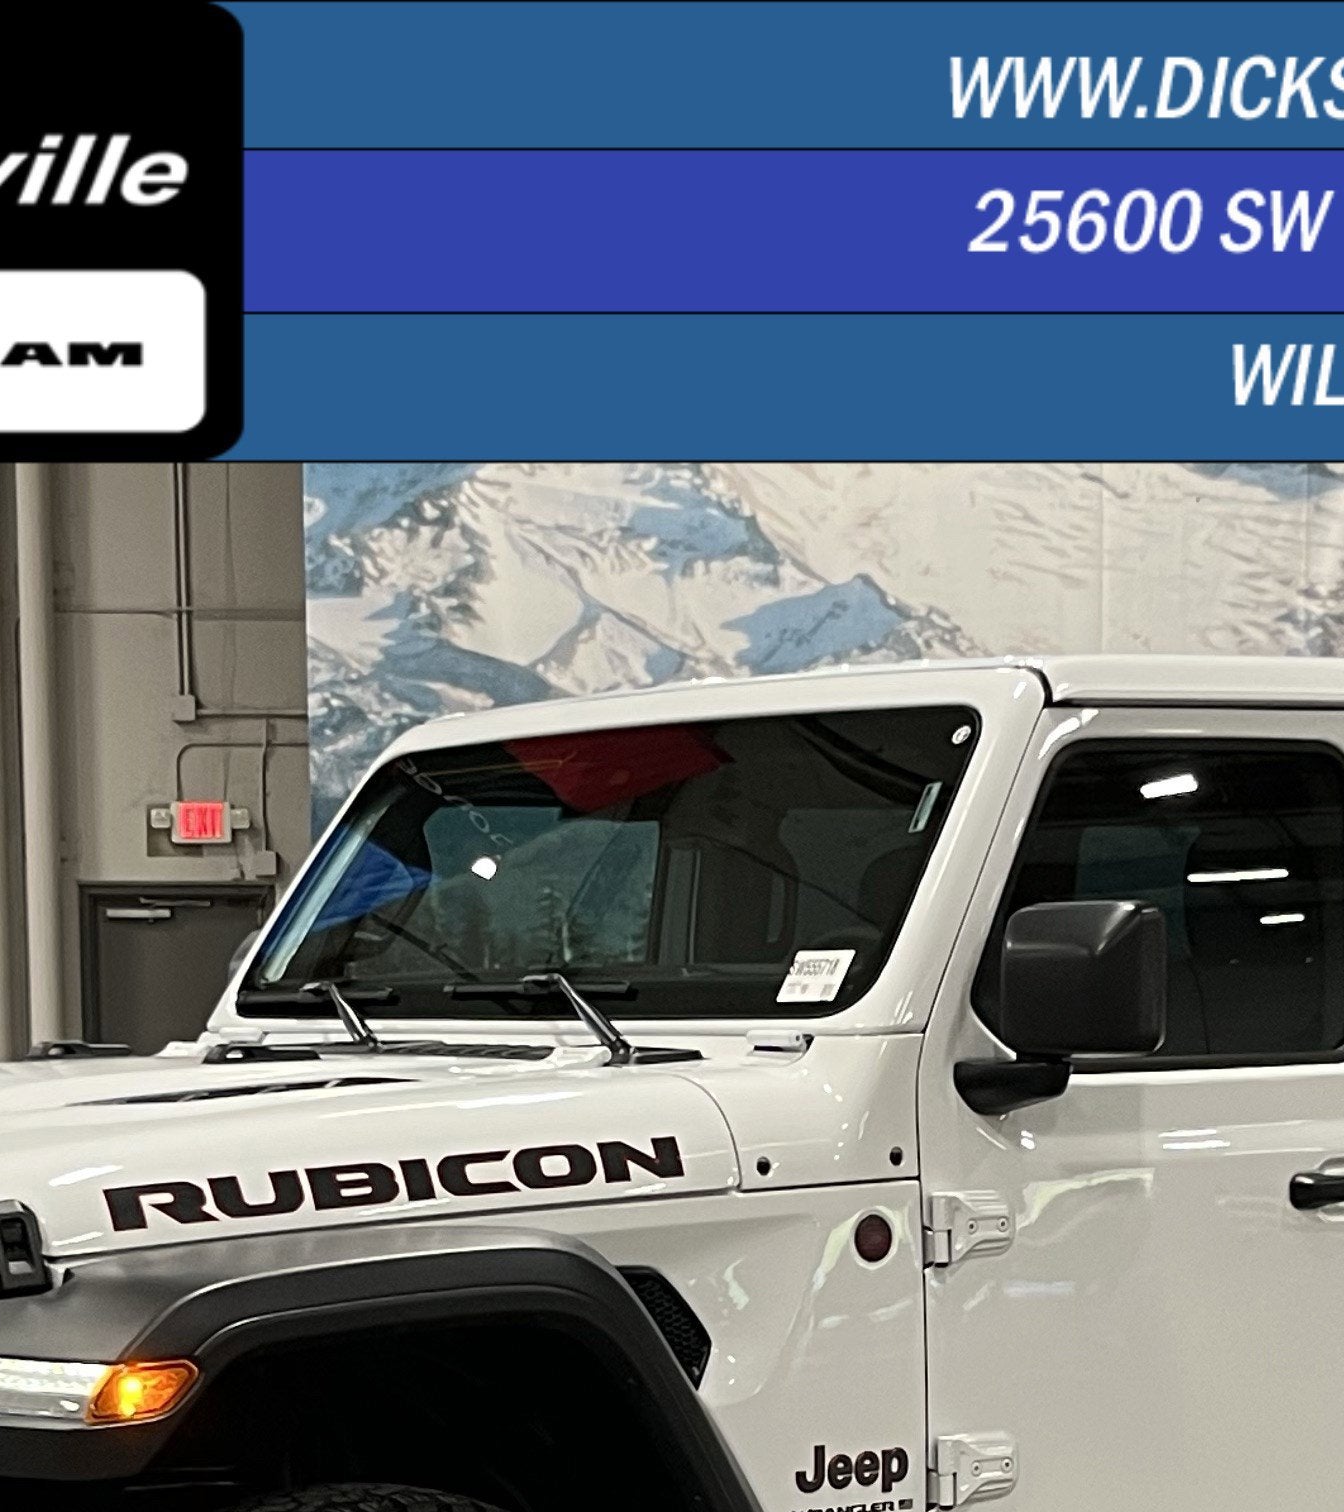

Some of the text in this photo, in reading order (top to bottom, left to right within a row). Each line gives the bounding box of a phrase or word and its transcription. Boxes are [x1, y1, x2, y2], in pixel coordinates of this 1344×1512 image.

[181, 804, 223, 837] EXIT
[103, 1136, 685, 1231] RUBICON
[795, 1445, 909, 1493] Jeep
